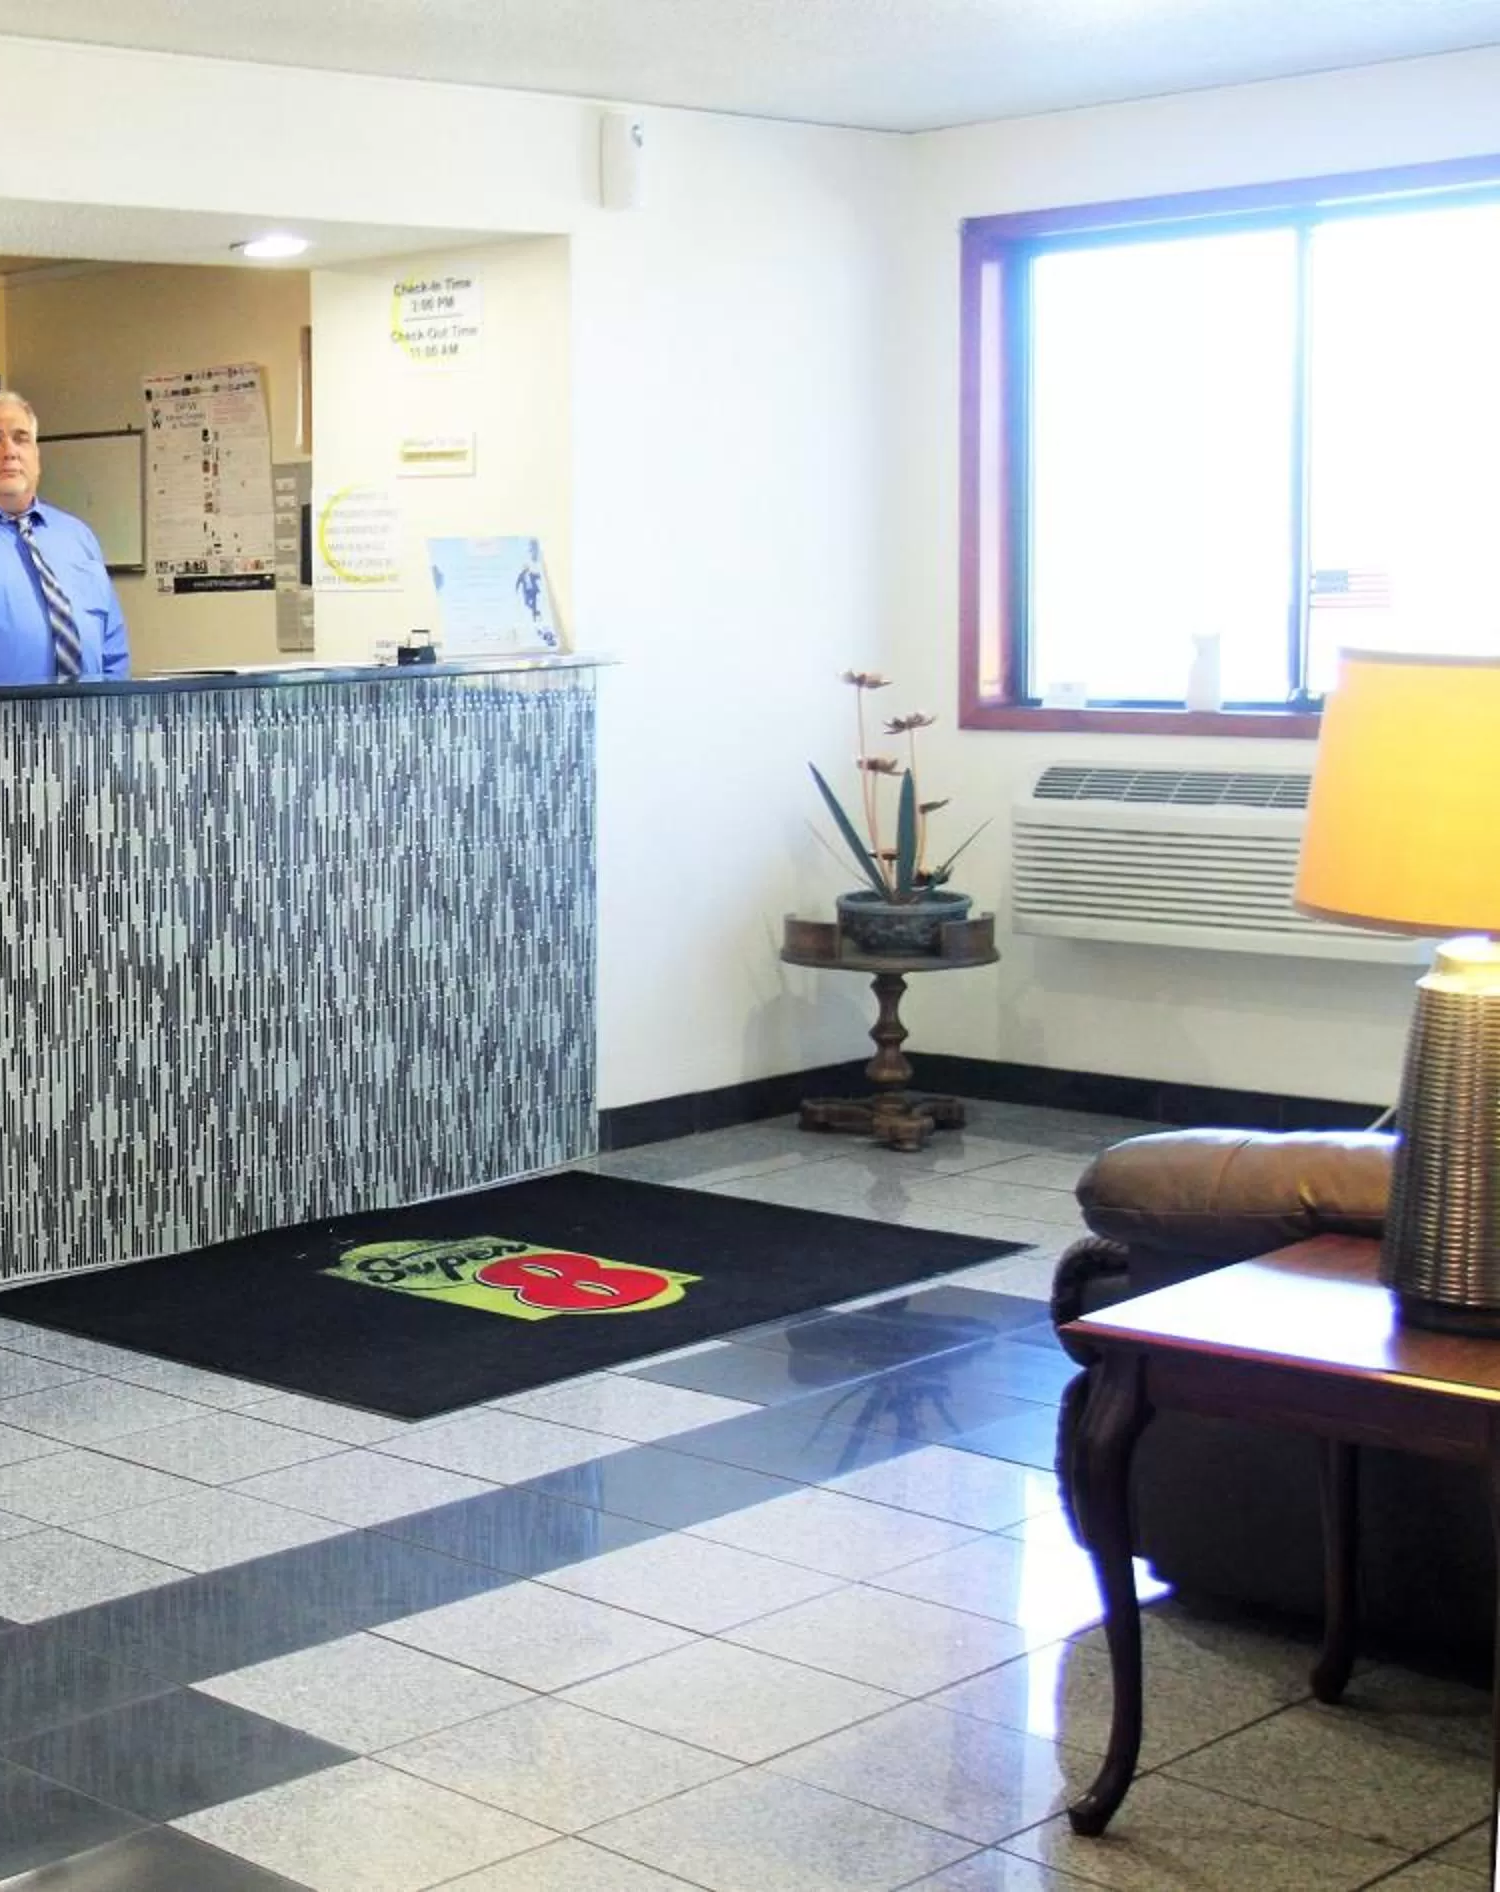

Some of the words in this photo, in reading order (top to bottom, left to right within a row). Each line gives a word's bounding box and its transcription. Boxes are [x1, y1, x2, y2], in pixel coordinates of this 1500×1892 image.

[444, 277, 472, 291] Time
[437, 295, 455, 309] PM
[451, 324, 478, 338] Time
[356, 1243, 529, 1283] Super
[473, 1252, 670, 1311] 8
